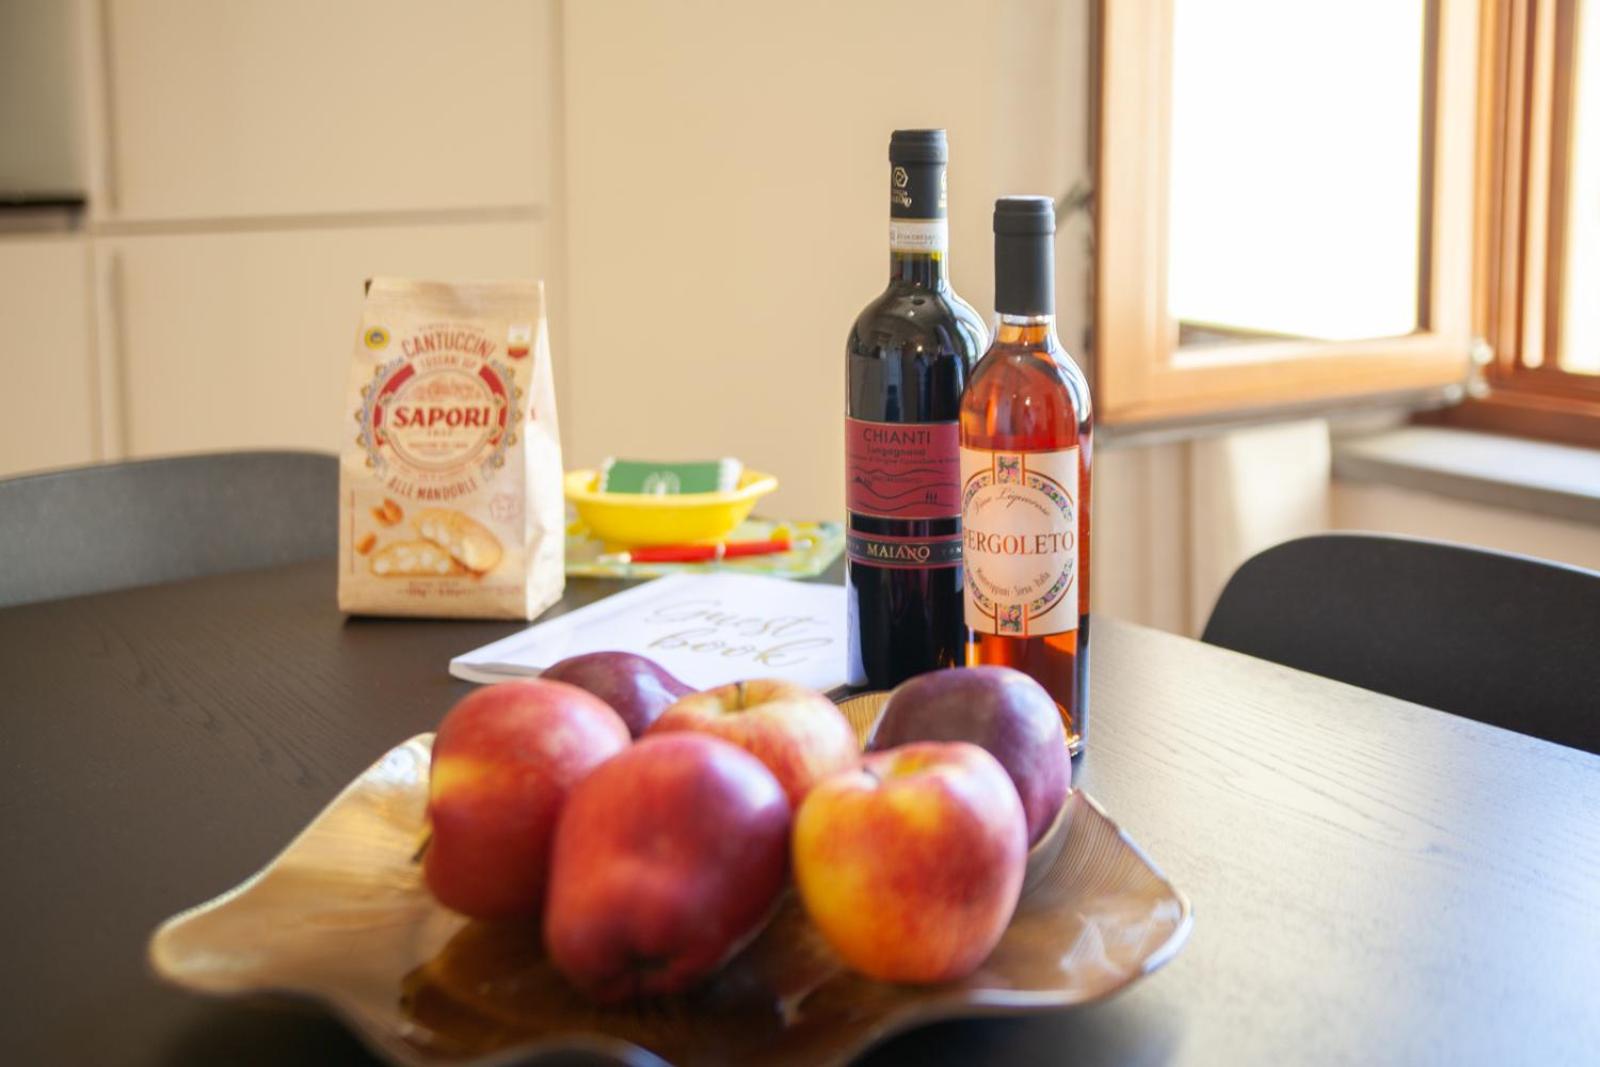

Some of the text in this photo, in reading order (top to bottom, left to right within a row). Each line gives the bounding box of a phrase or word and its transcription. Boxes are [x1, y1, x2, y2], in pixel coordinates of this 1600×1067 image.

[401, 330, 497, 359] CANTUCCINI
[393, 406, 491, 428] SAPORI
[863, 427, 931, 445] CHIANTI
[387, 475, 414, 498] ALLE
[417, 476, 478, 501] MANDORLE
[866, 543, 930, 563] MAIANO
[644, 600, 828, 638] Guest
[647, 627, 834, 668] book
